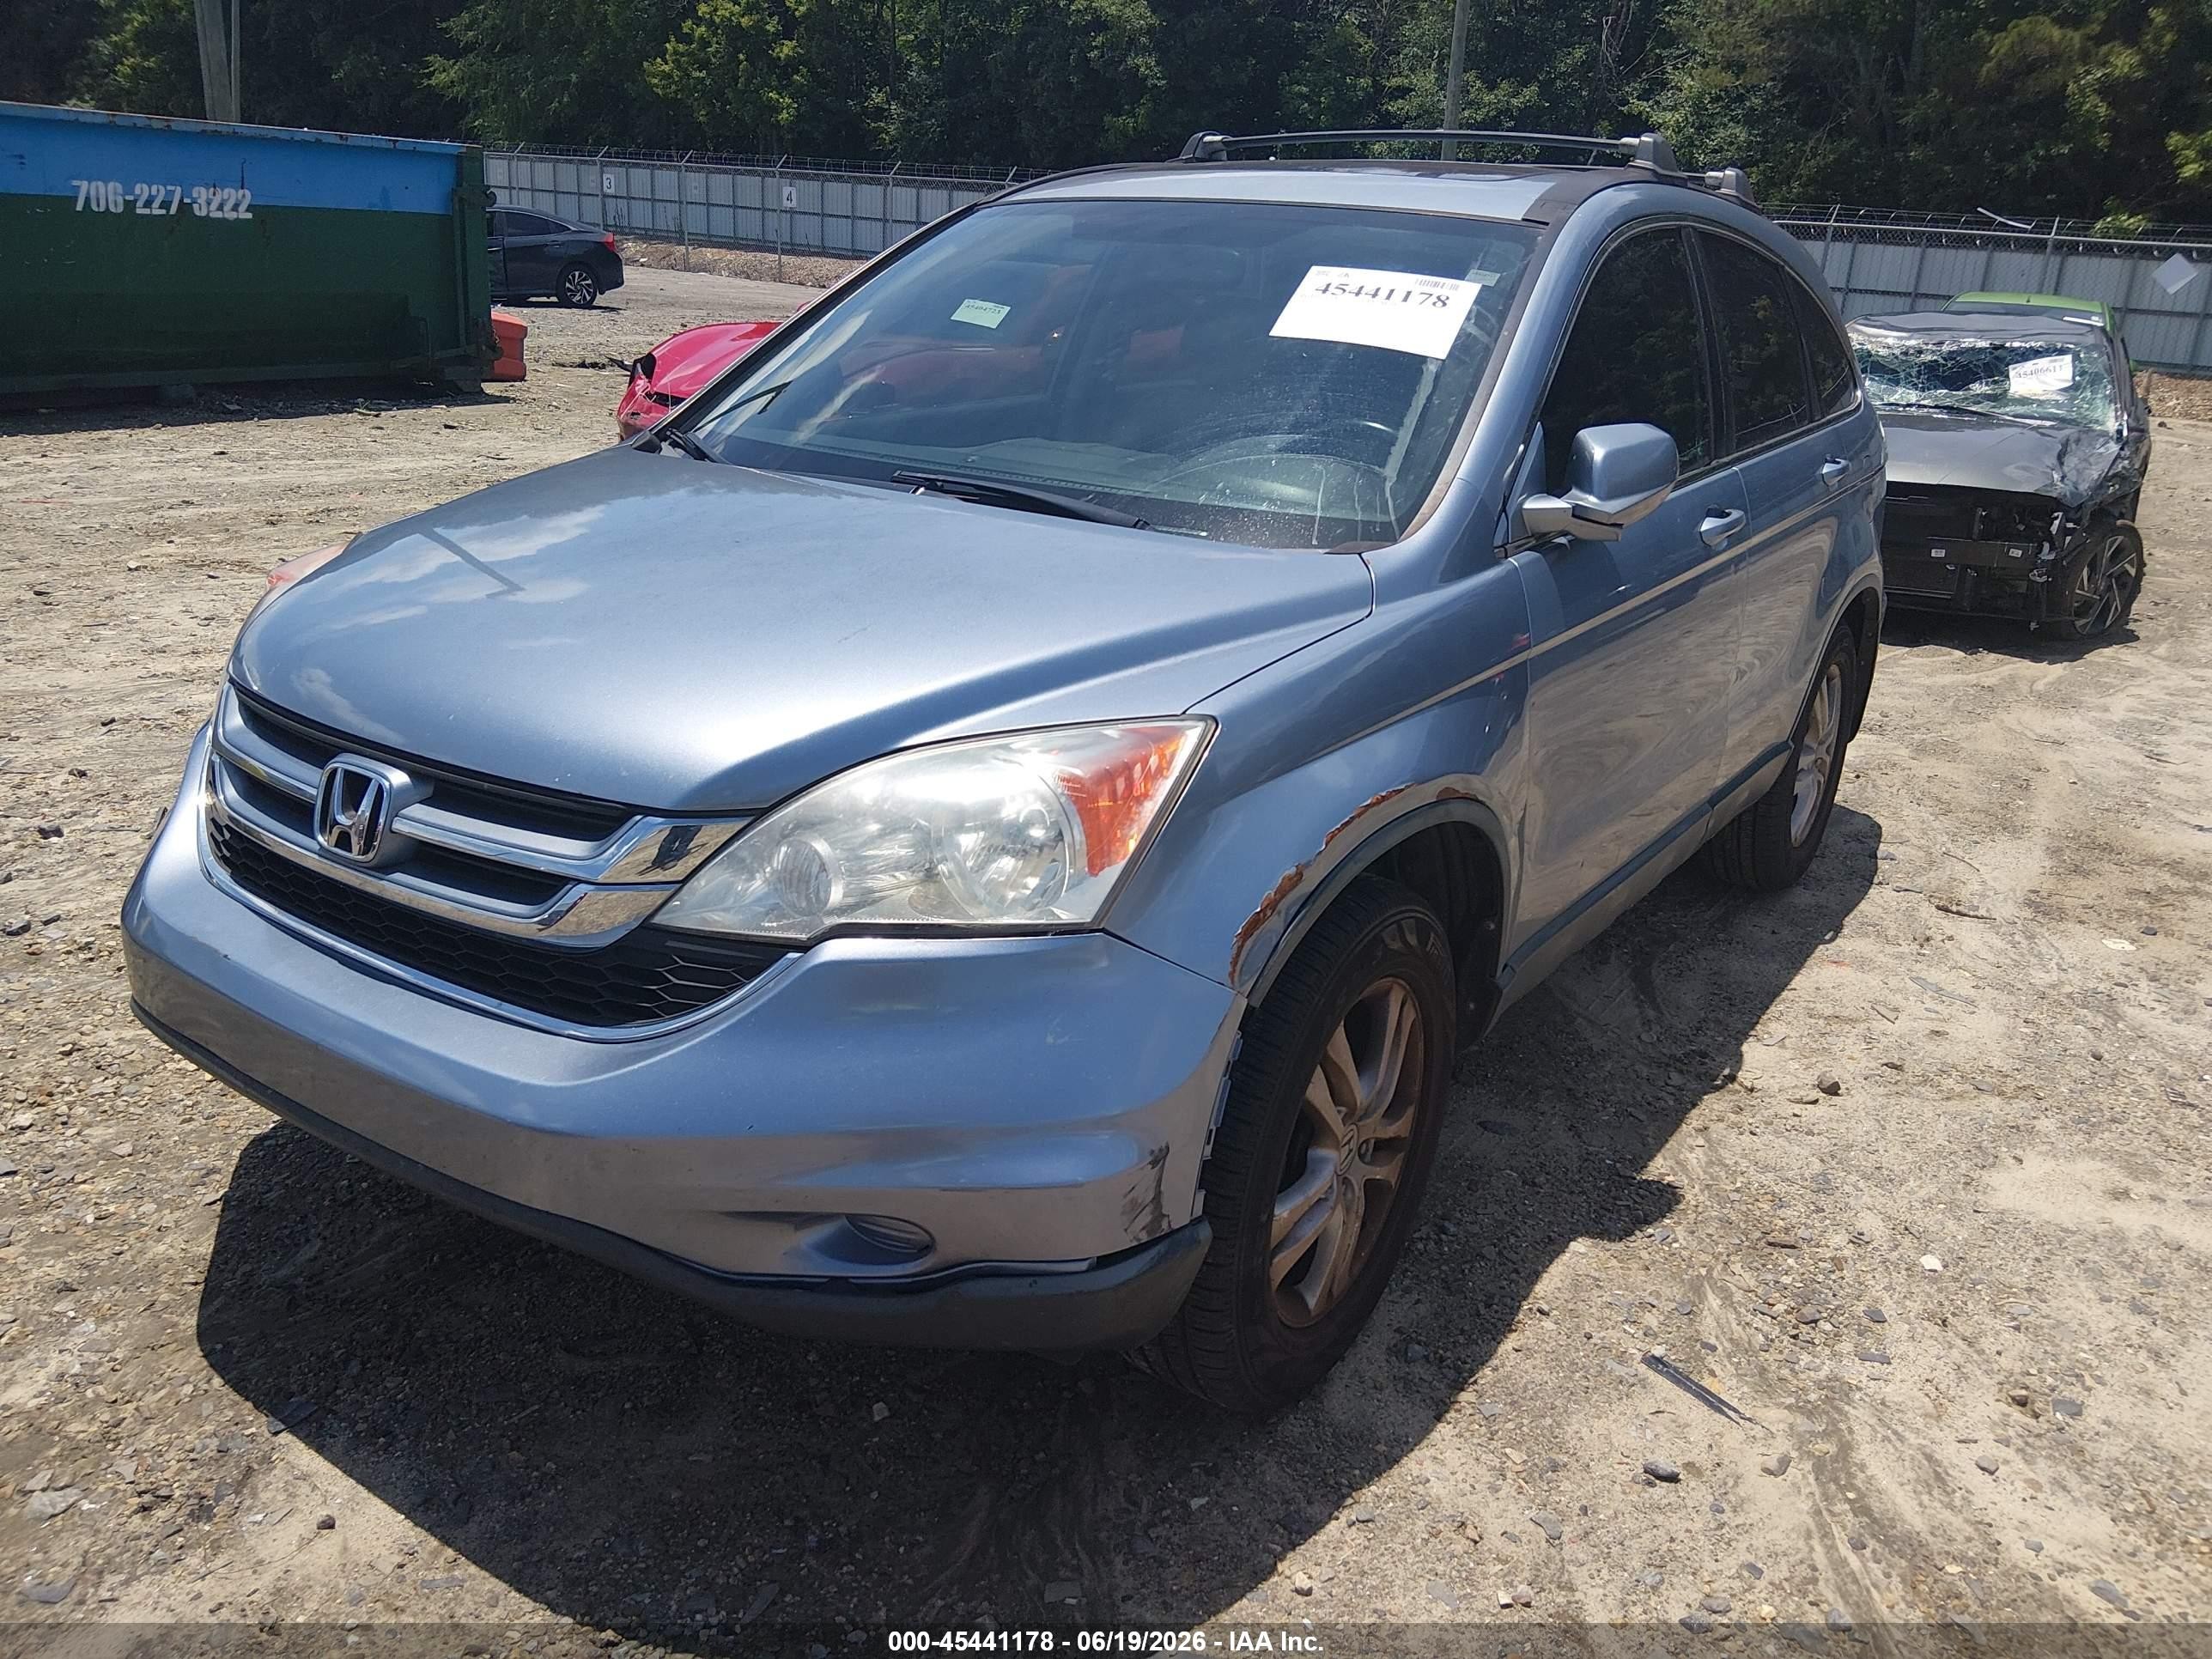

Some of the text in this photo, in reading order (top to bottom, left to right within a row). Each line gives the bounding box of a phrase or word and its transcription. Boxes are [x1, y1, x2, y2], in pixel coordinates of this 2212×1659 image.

[605, 177, 612, 190] 3
[71, 179, 252, 220] 706-227-3222
[786, 190, 793, 204] 4
[1314, 282, 1450, 308] 45441178
